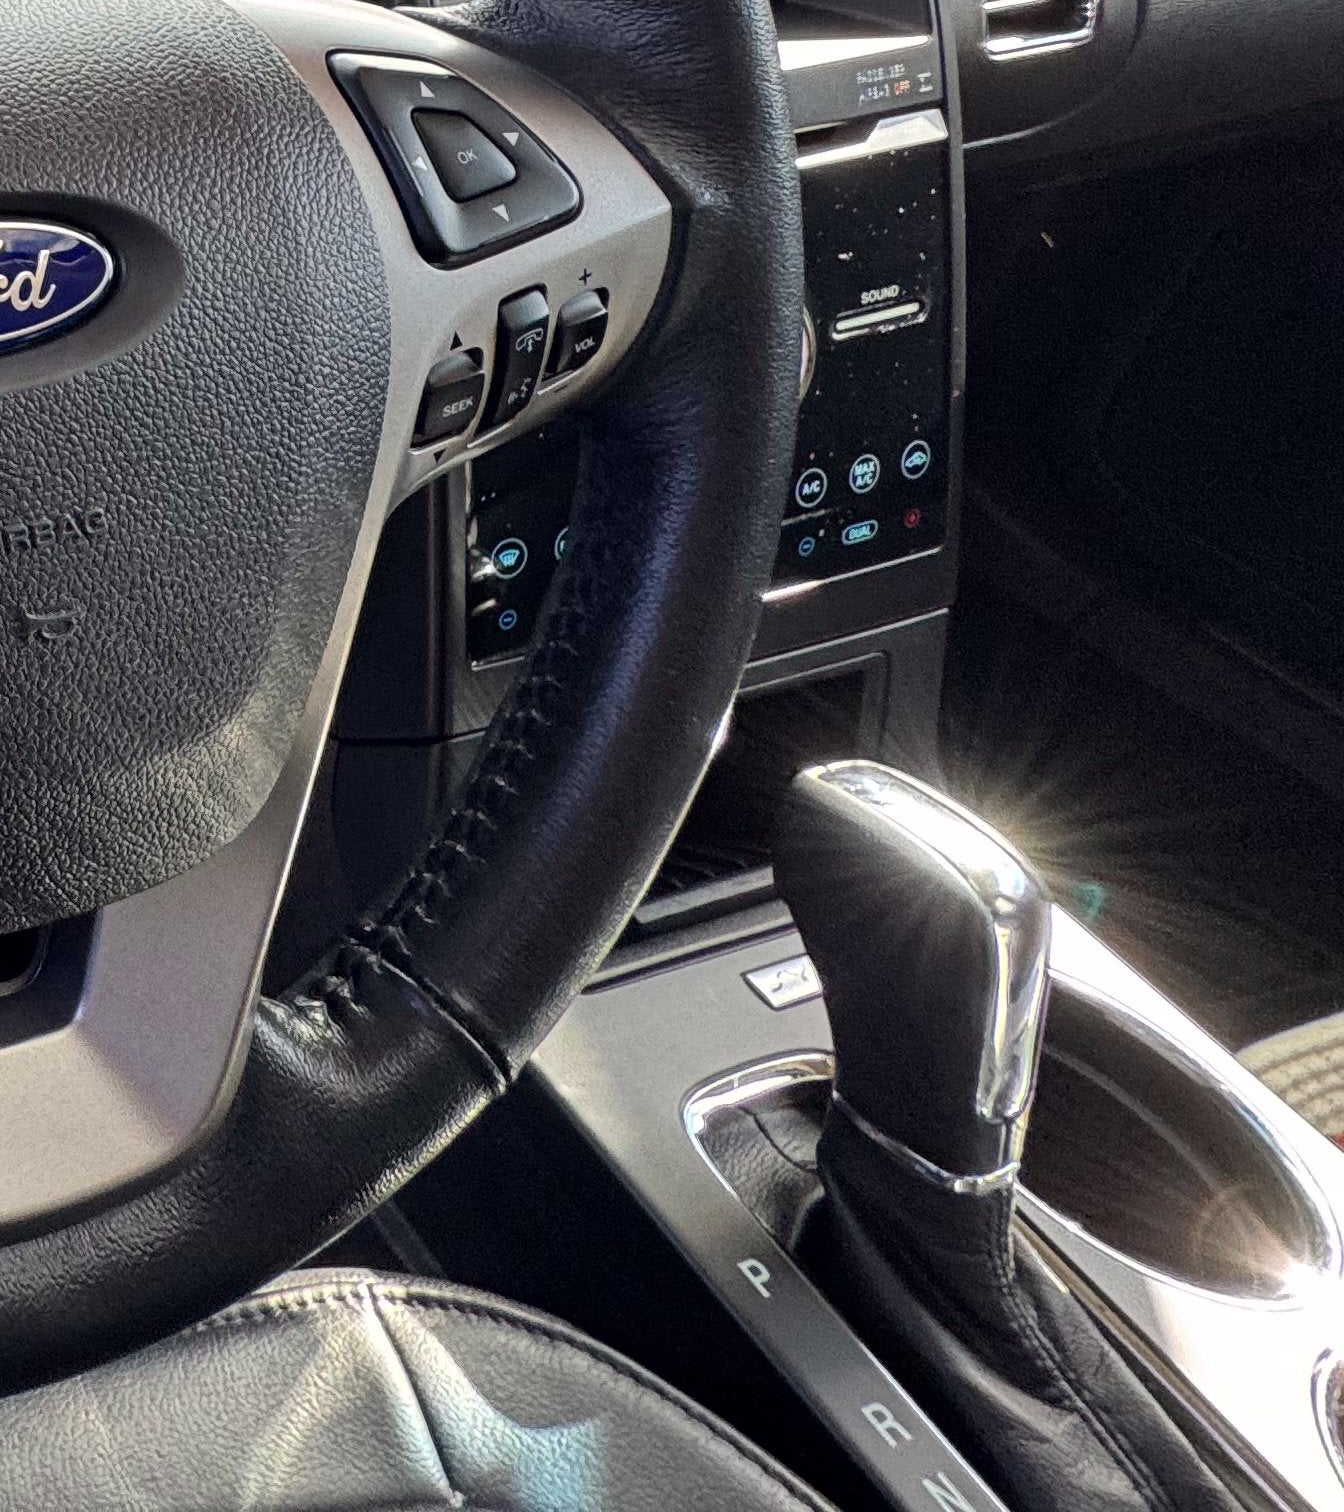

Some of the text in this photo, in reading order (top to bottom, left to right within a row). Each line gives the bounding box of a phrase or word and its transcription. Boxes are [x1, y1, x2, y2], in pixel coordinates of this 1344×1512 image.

[457, 148, 476, 164] OK
[861, 285, 899, 304] SOUND
[574, 336, 596, 354] VOL
[442, 396, 474, 418] SEEK
[855, 461, 875, 475] MAX
[802, 480, 821, 496] A/C
[737, 1258, 772, 1299] P
[861, 1402, 913, 1449] R
